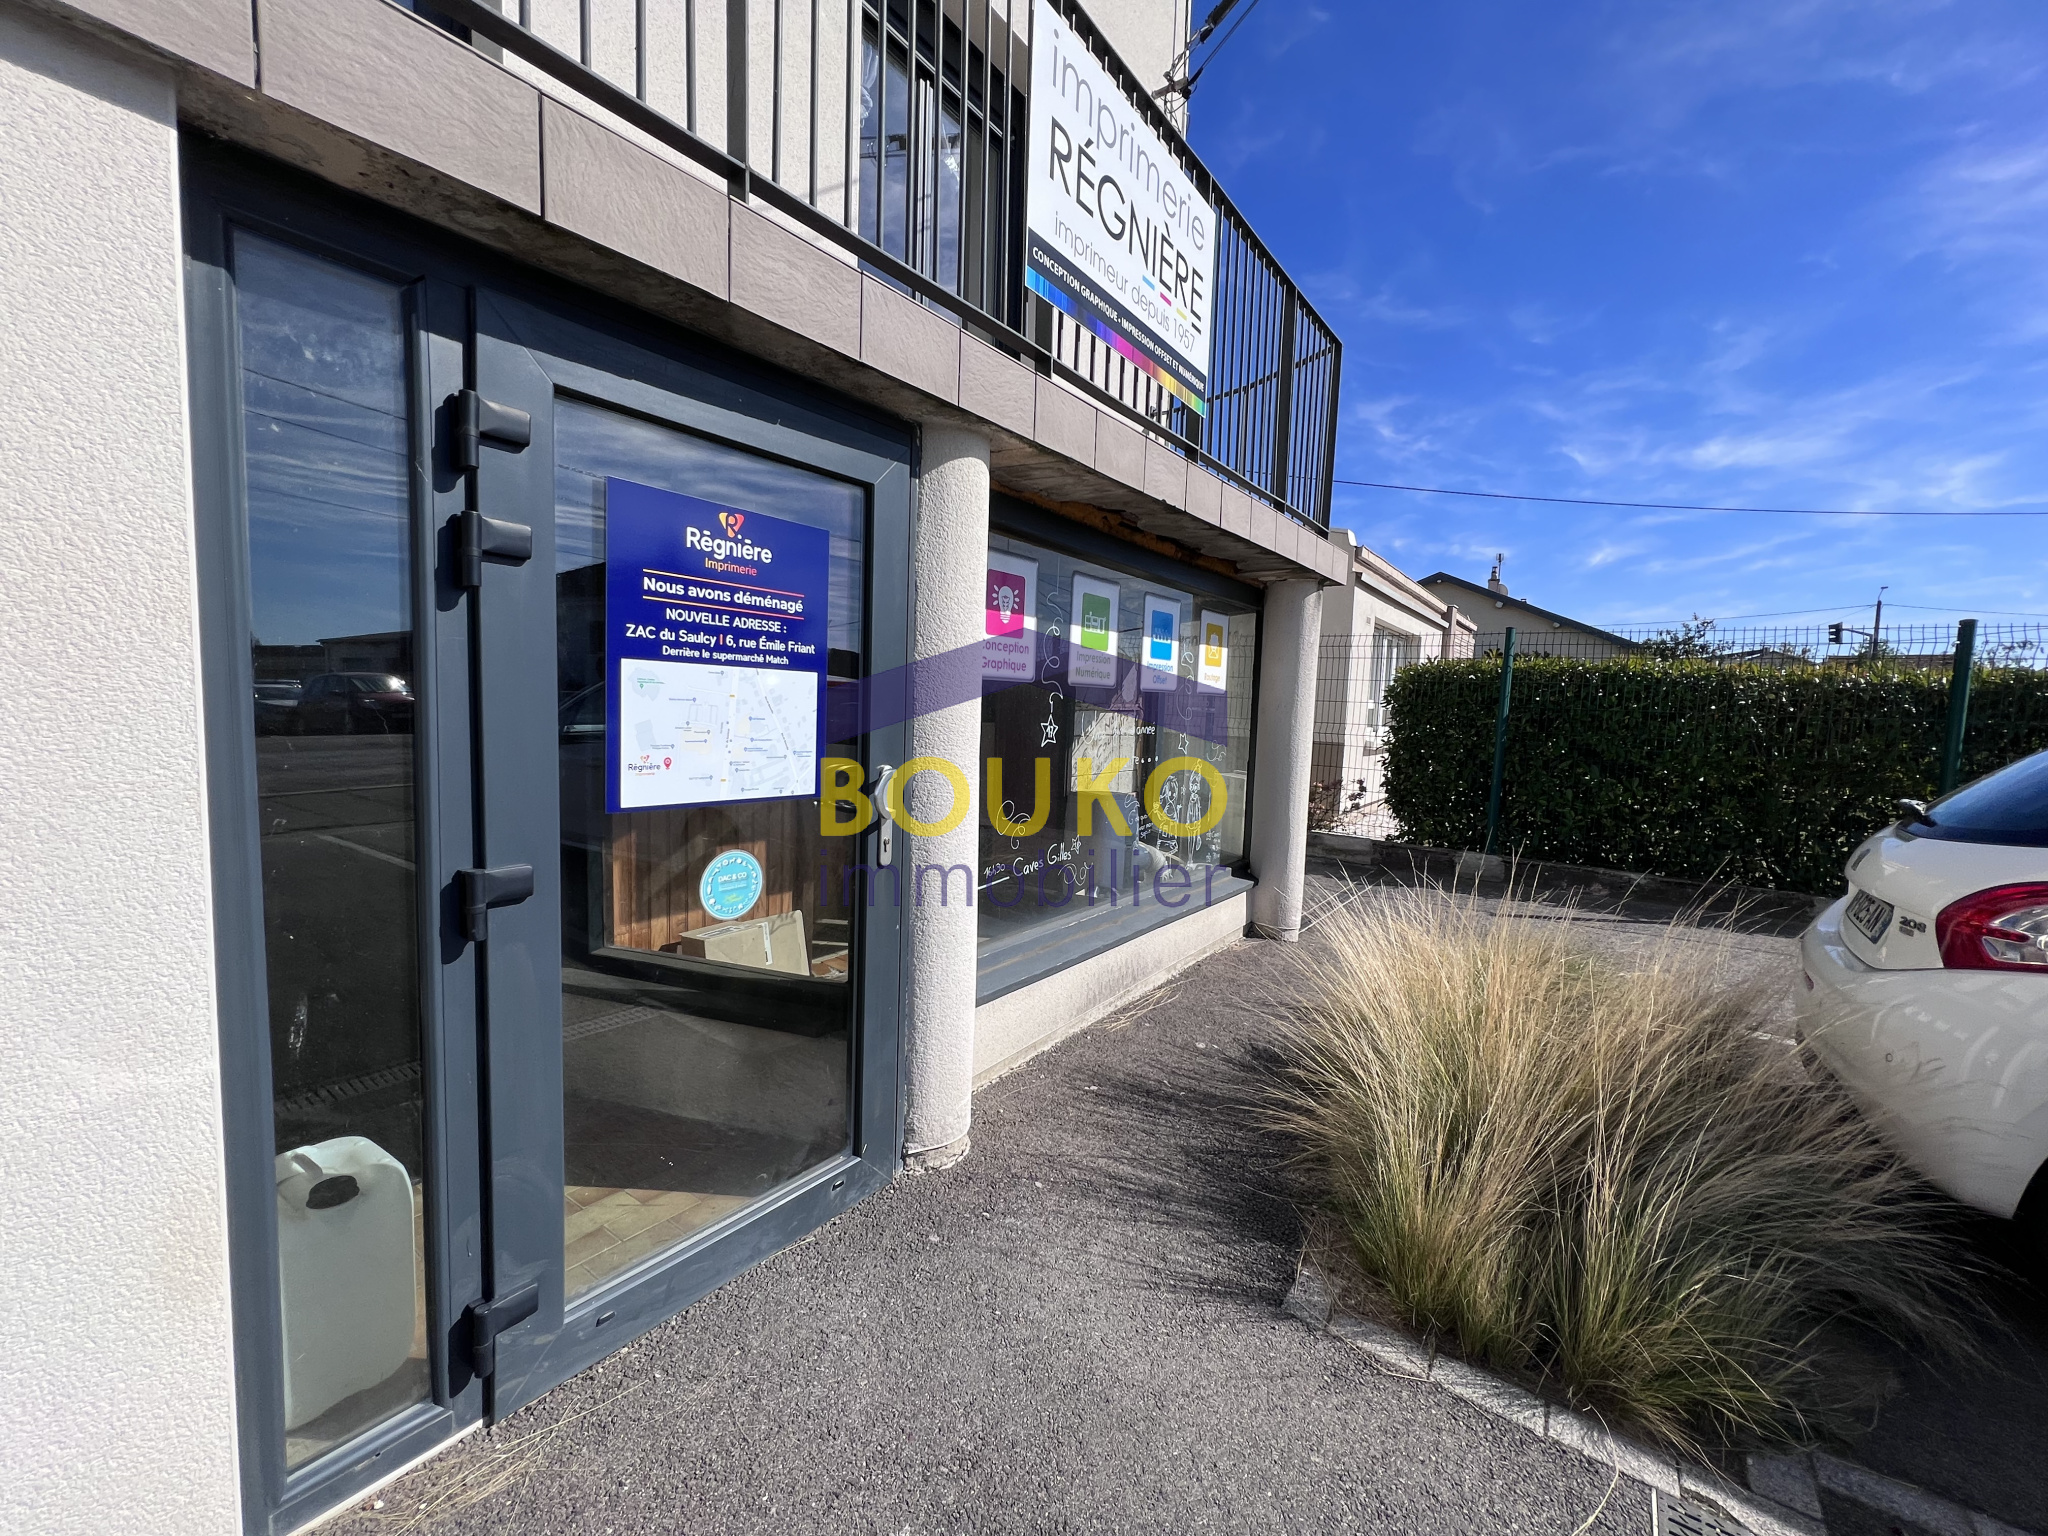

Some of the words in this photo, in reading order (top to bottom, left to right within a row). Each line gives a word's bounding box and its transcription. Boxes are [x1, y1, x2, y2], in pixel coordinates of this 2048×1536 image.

[1052, 28, 1205, 251] imprimerie
[1050, 115, 1204, 323] RÉGNIÈRE
[1055, 211, 1129, 295] imprimeur
[1131, 286, 1170, 332] depuis
[1173, 318, 1195, 352] 1957
[1032, 246, 1080, 293] CONCEPTION
[1081, 285, 1118, 323] GRAPHIQUE
[1121, 317, 1155, 352] IMPRESSION
[1154, 345, 1173, 366] OFFSET
[1172, 360, 1180, 371] ET
[1179, 364, 1205, 392] NUMÉRIQUE
[705, 557, 758, 576] Imprimerie
[643, 576, 685, 596] Nous
[687, 586, 731, 602] avons
[733, 591, 804, 614] déménagé
[666, 607, 731, 627] NOUVELLE
[732, 616, 782, 633] ADRESSE
[625, 623, 656, 639] ZAC
[659, 628, 676, 641] du
[679, 629, 717, 648] Saulcy
[725, 634, 736, 649] 6,
[739, 638, 757, 649] rue
[759, 635, 786, 652] Émile
[788, 640, 816, 655] Friant
[662, 645, 700, 658] Derrière
[701, 648, 711, 659] le
[712, 652, 765, 663] supermarché
[765, 654, 789, 665] Match
[982, 640, 1029, 656] onception
[1075, 666, 1111, 681] Numérique
[1076, 651, 1111, 665] Impression
[1012, 857, 1044, 877] Caves
[1047, 842, 1072, 865] Gilles
